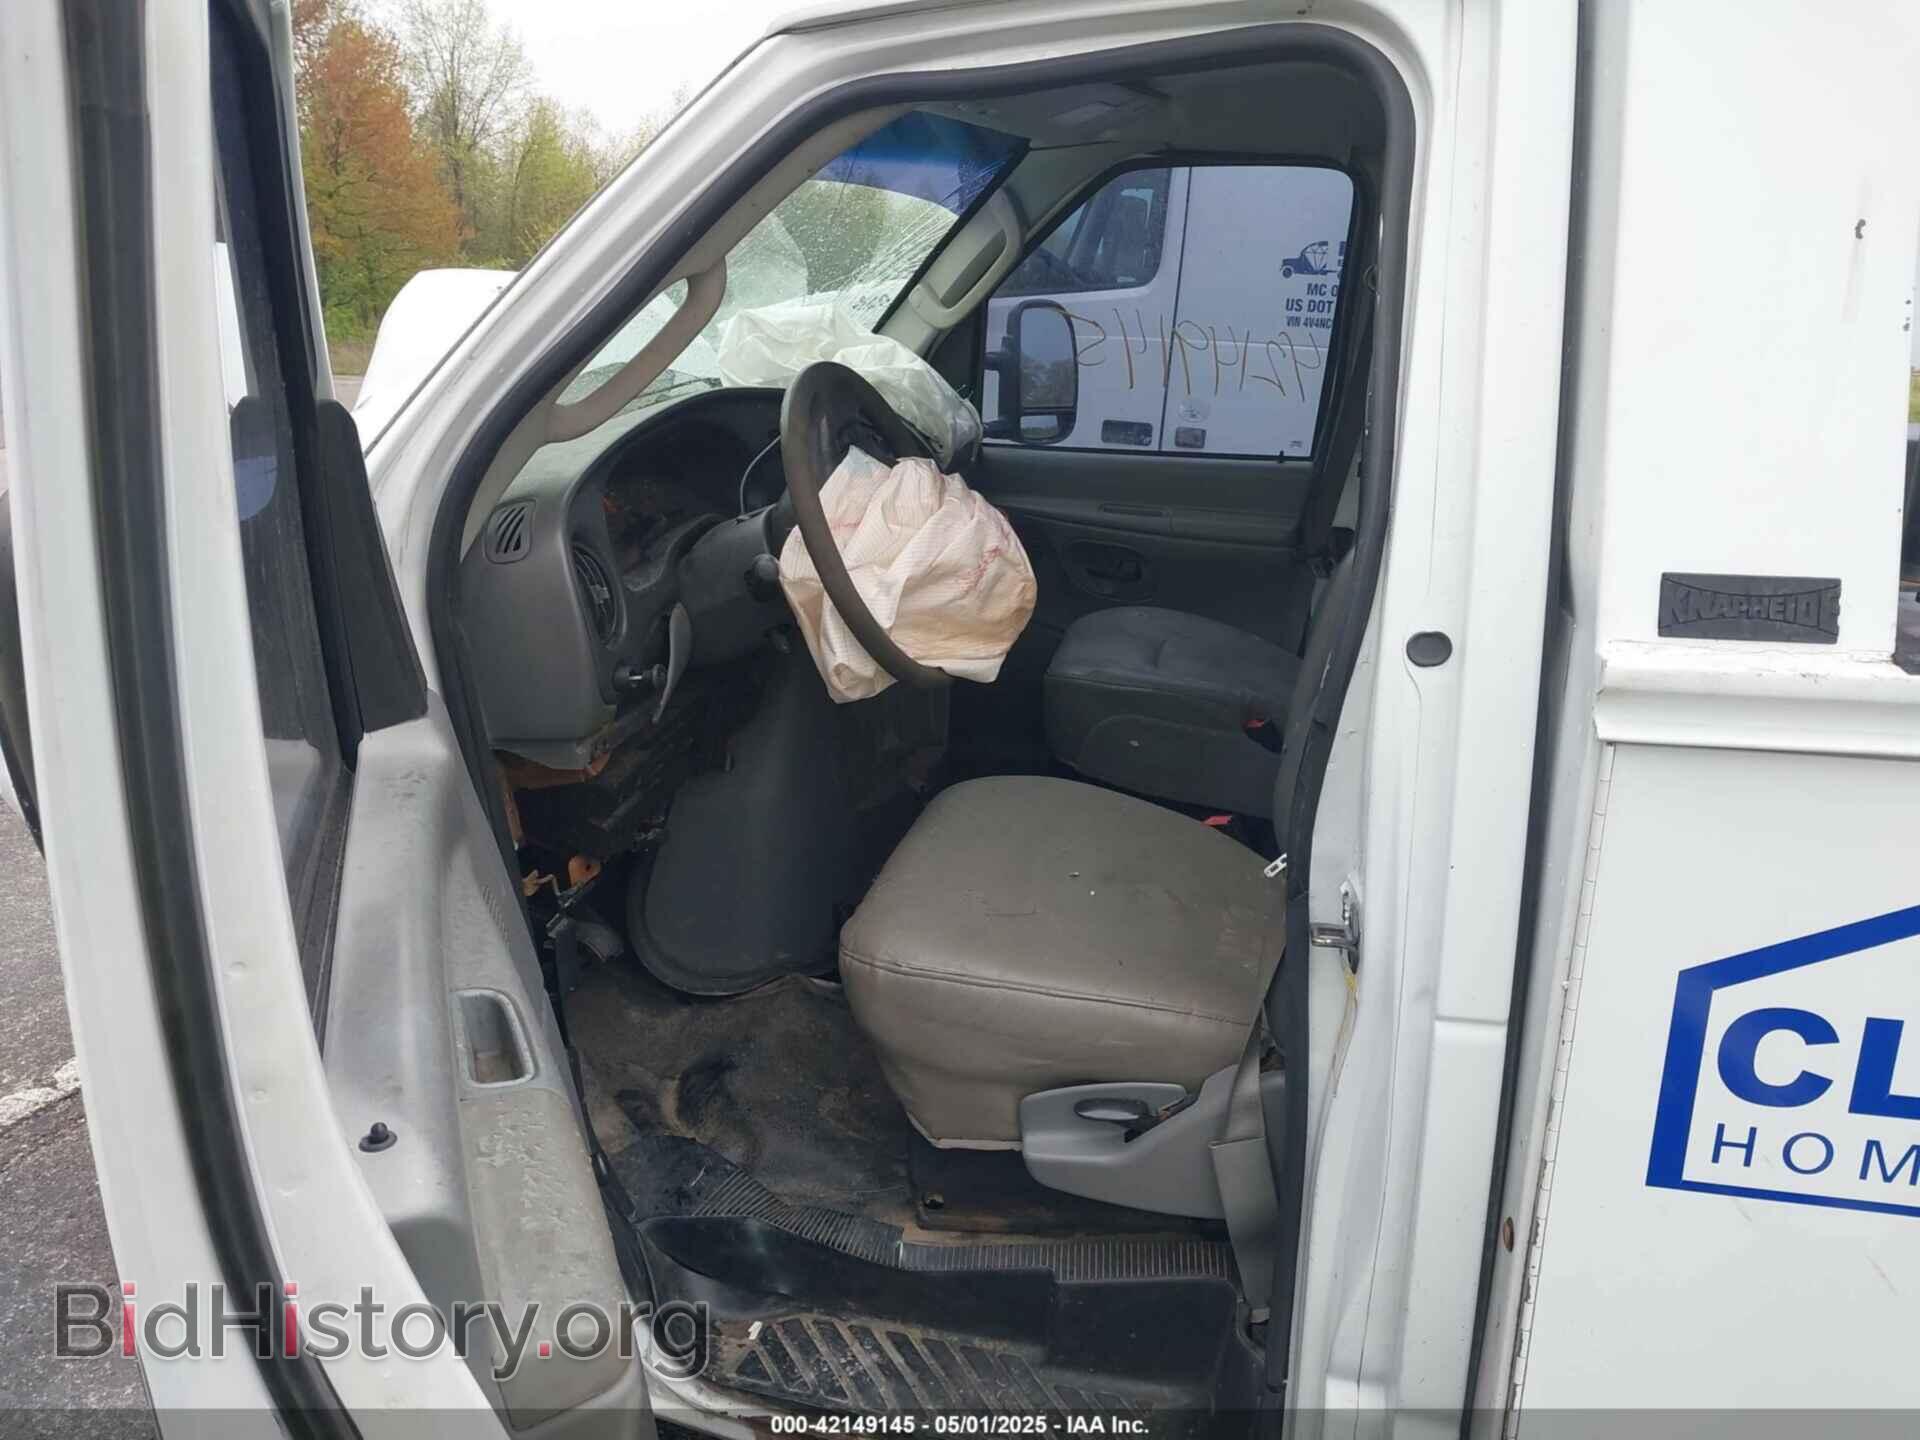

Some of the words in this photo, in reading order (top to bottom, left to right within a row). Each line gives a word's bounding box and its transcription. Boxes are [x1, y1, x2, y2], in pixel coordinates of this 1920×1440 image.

[1306, 282, 1327, 297] MC
[1285, 298, 1304, 312] US
[1307, 299, 1334, 314] DOT
[1286, 315, 1301, 328] VIN
[1716, 1006, 1920, 1121] CL
[1710, 1122, 1920, 1187] HOM
